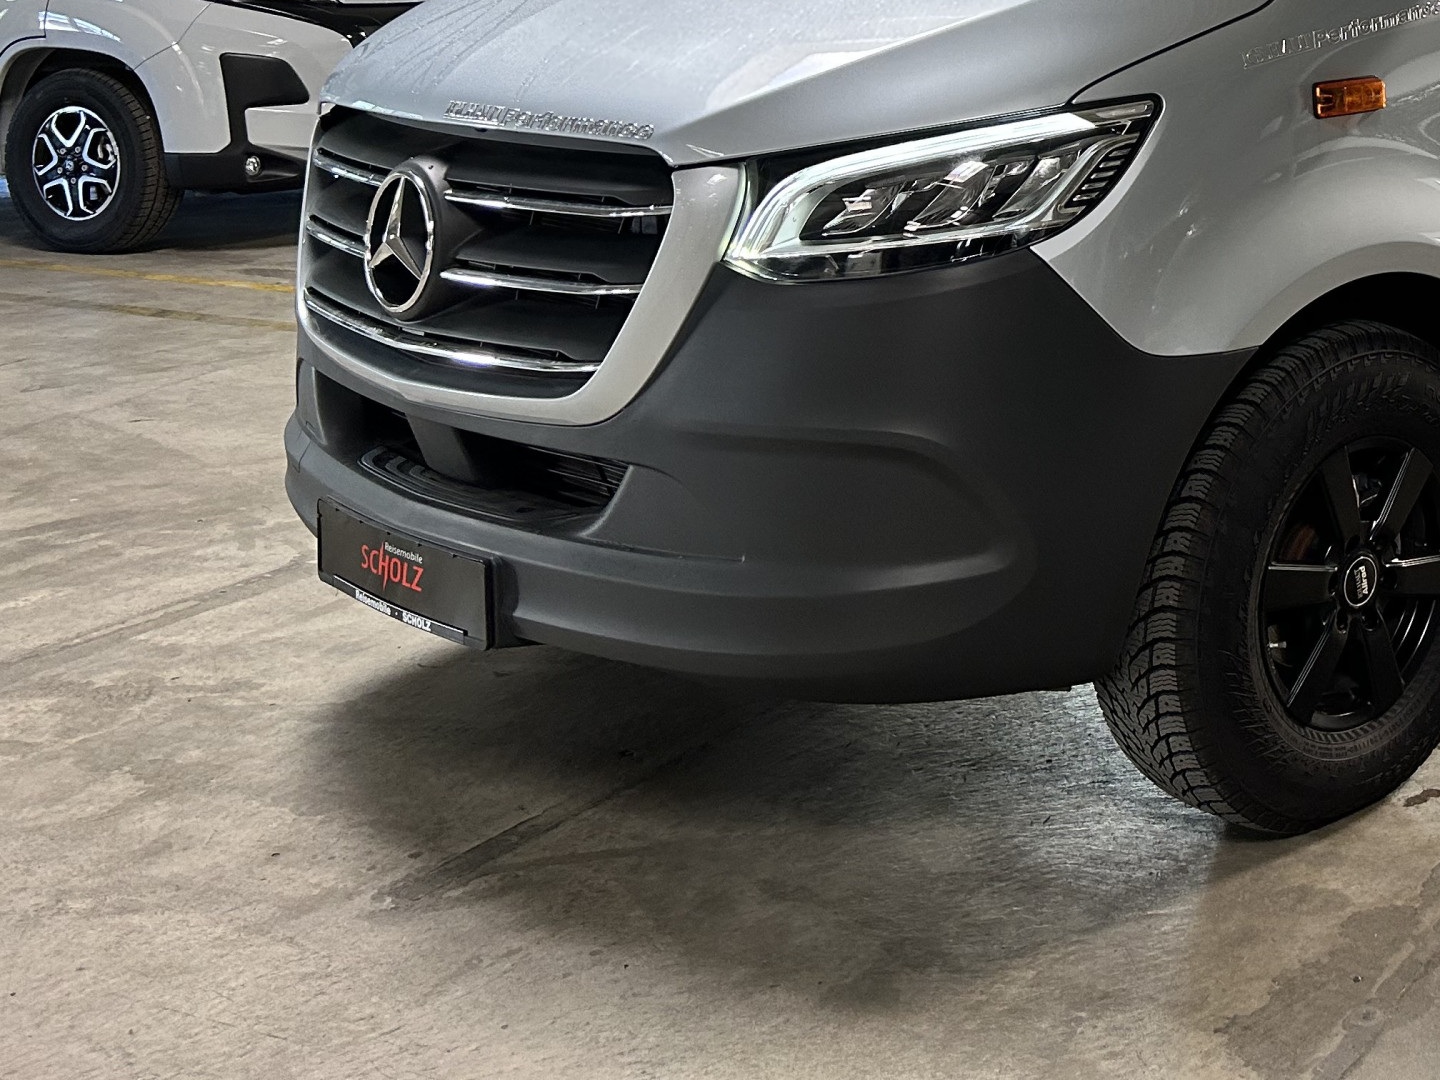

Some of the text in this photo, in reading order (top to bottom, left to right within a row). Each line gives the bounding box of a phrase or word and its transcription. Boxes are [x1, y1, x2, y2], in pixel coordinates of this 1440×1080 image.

[360, 541, 424, 593] SCHOLZ
[384, 541, 423, 565] Reisemobile
[355, 589, 432, 632] Reisemobile SCHOLZ
